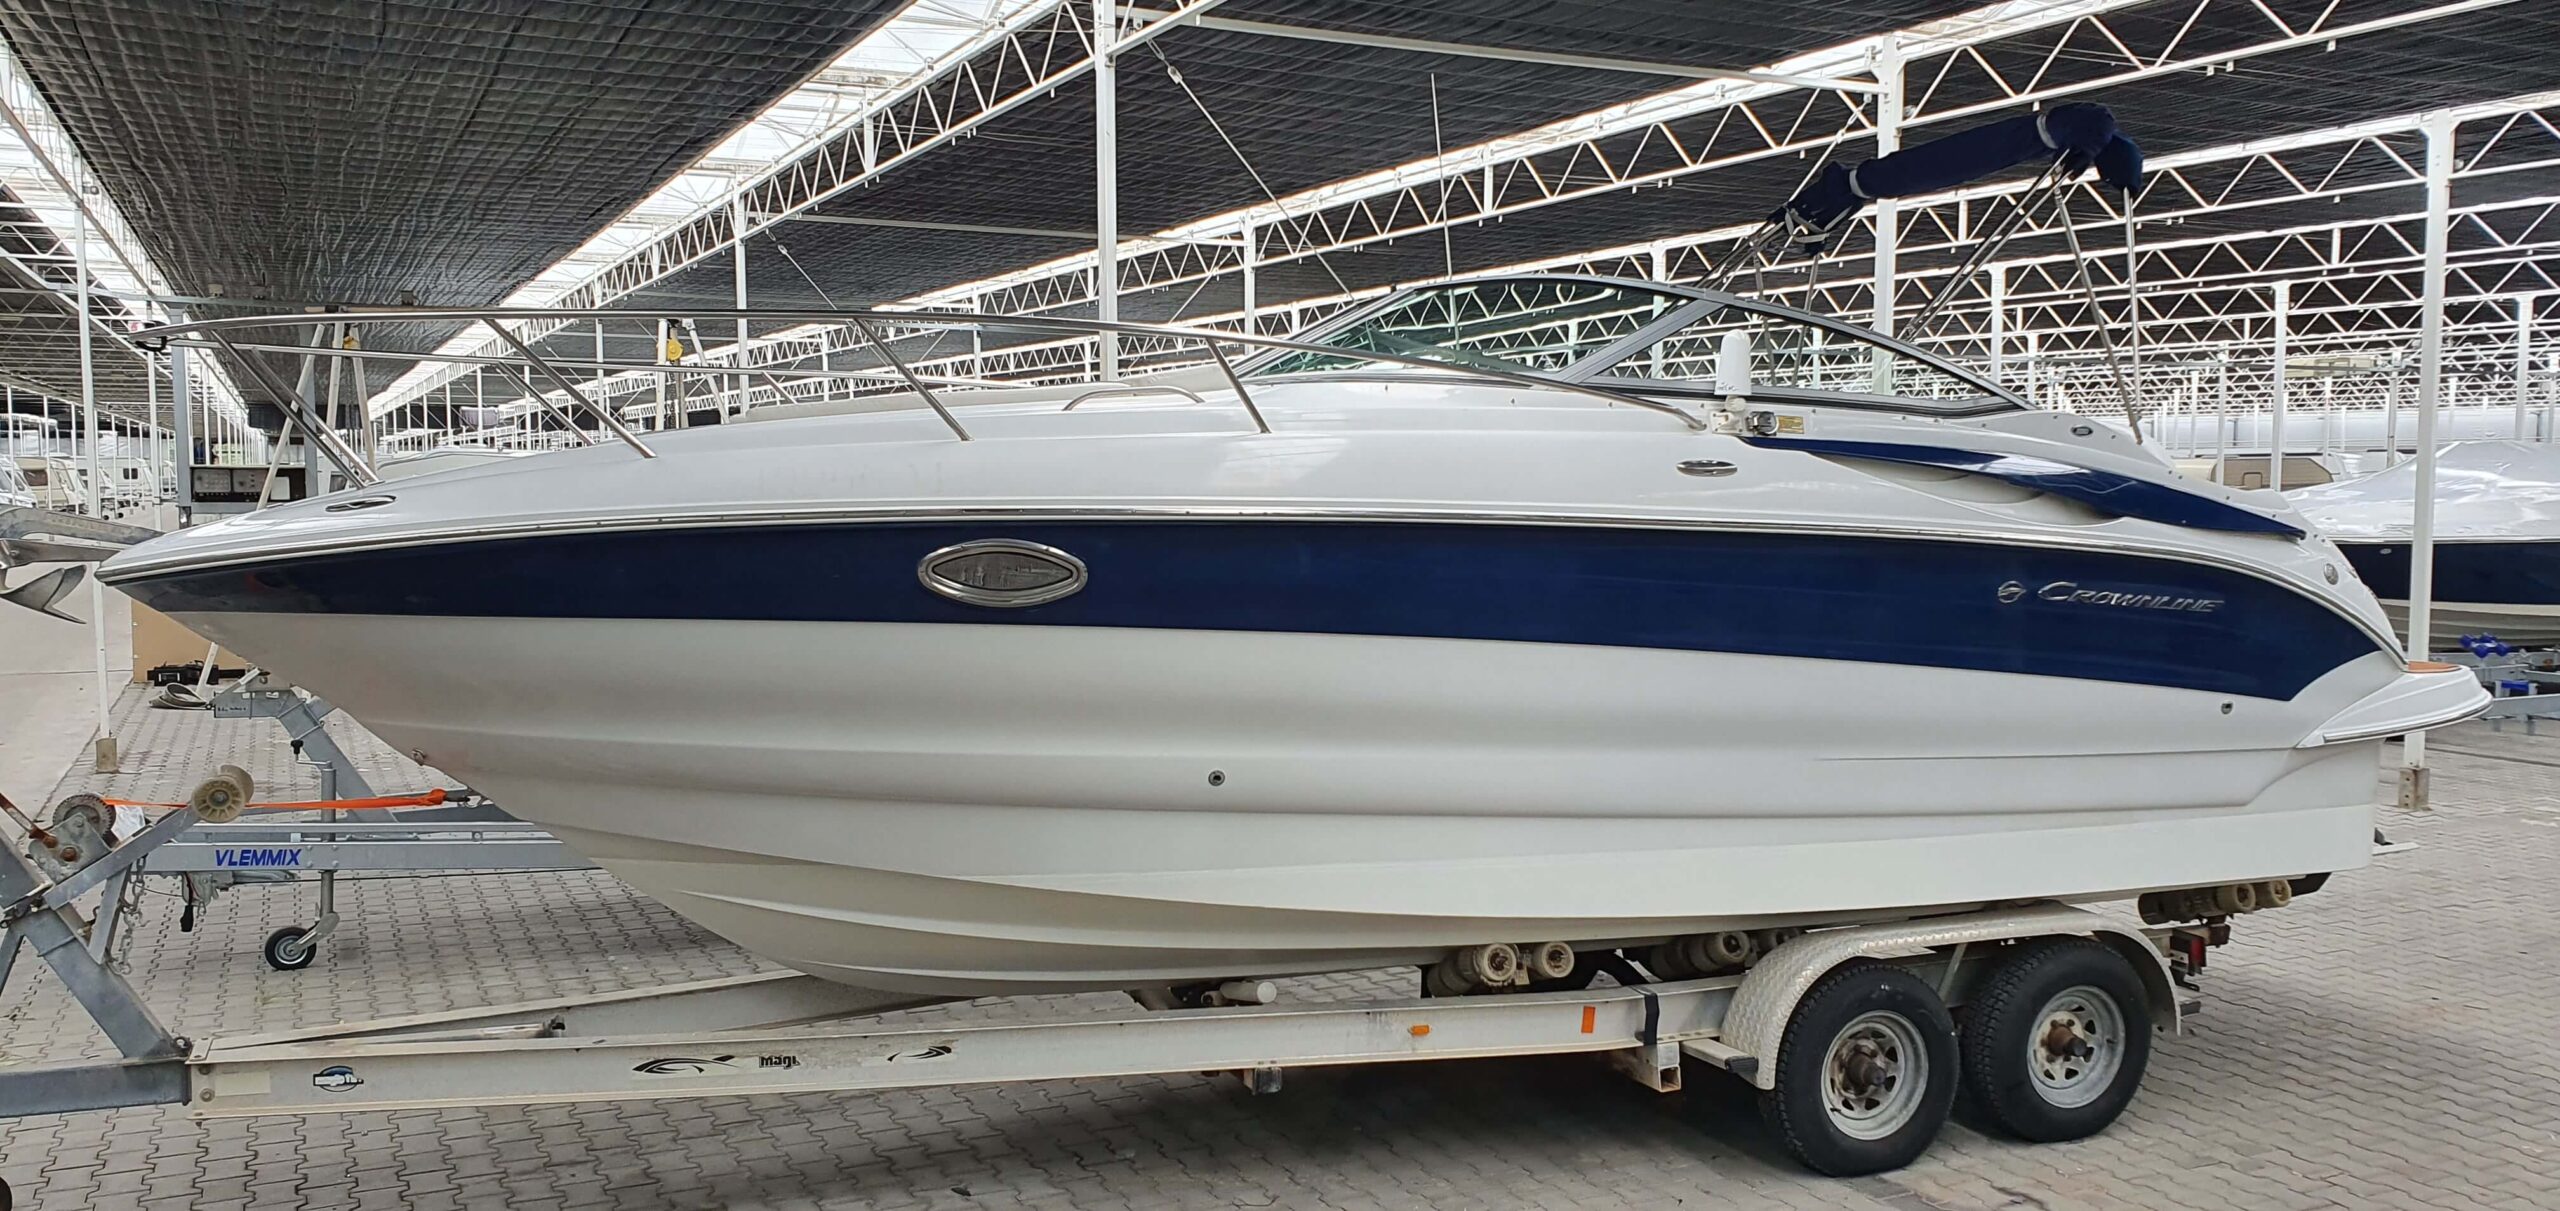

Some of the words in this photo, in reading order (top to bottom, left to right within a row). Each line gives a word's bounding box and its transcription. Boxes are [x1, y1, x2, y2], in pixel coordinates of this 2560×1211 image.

[2038, 581, 2224, 612] CROWNLINE
[215, 849, 302, 866] VLEMMIX
[759, 1055, 800, 1069] magi
